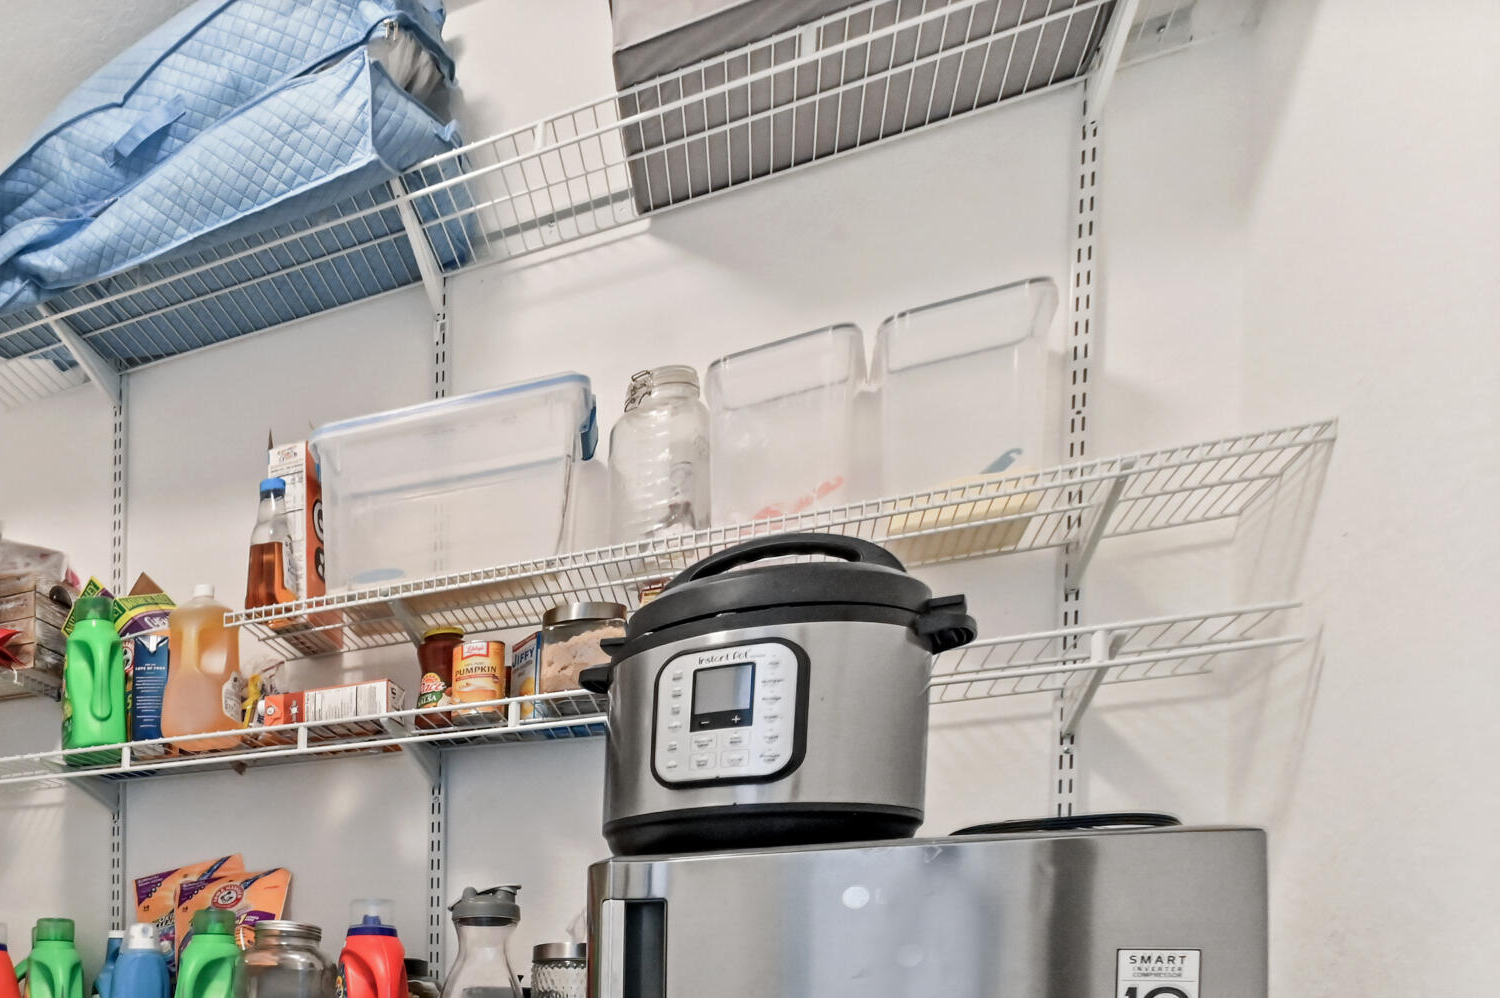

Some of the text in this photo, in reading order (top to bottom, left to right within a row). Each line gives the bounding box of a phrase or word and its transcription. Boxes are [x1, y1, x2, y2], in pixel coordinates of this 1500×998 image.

[512, 647, 535, 668] JIFFY
[698, 653, 730, 665] Instant
[455, 665, 497, 677] PUMPKIN
[1129, 955, 1187, 965] SMART
